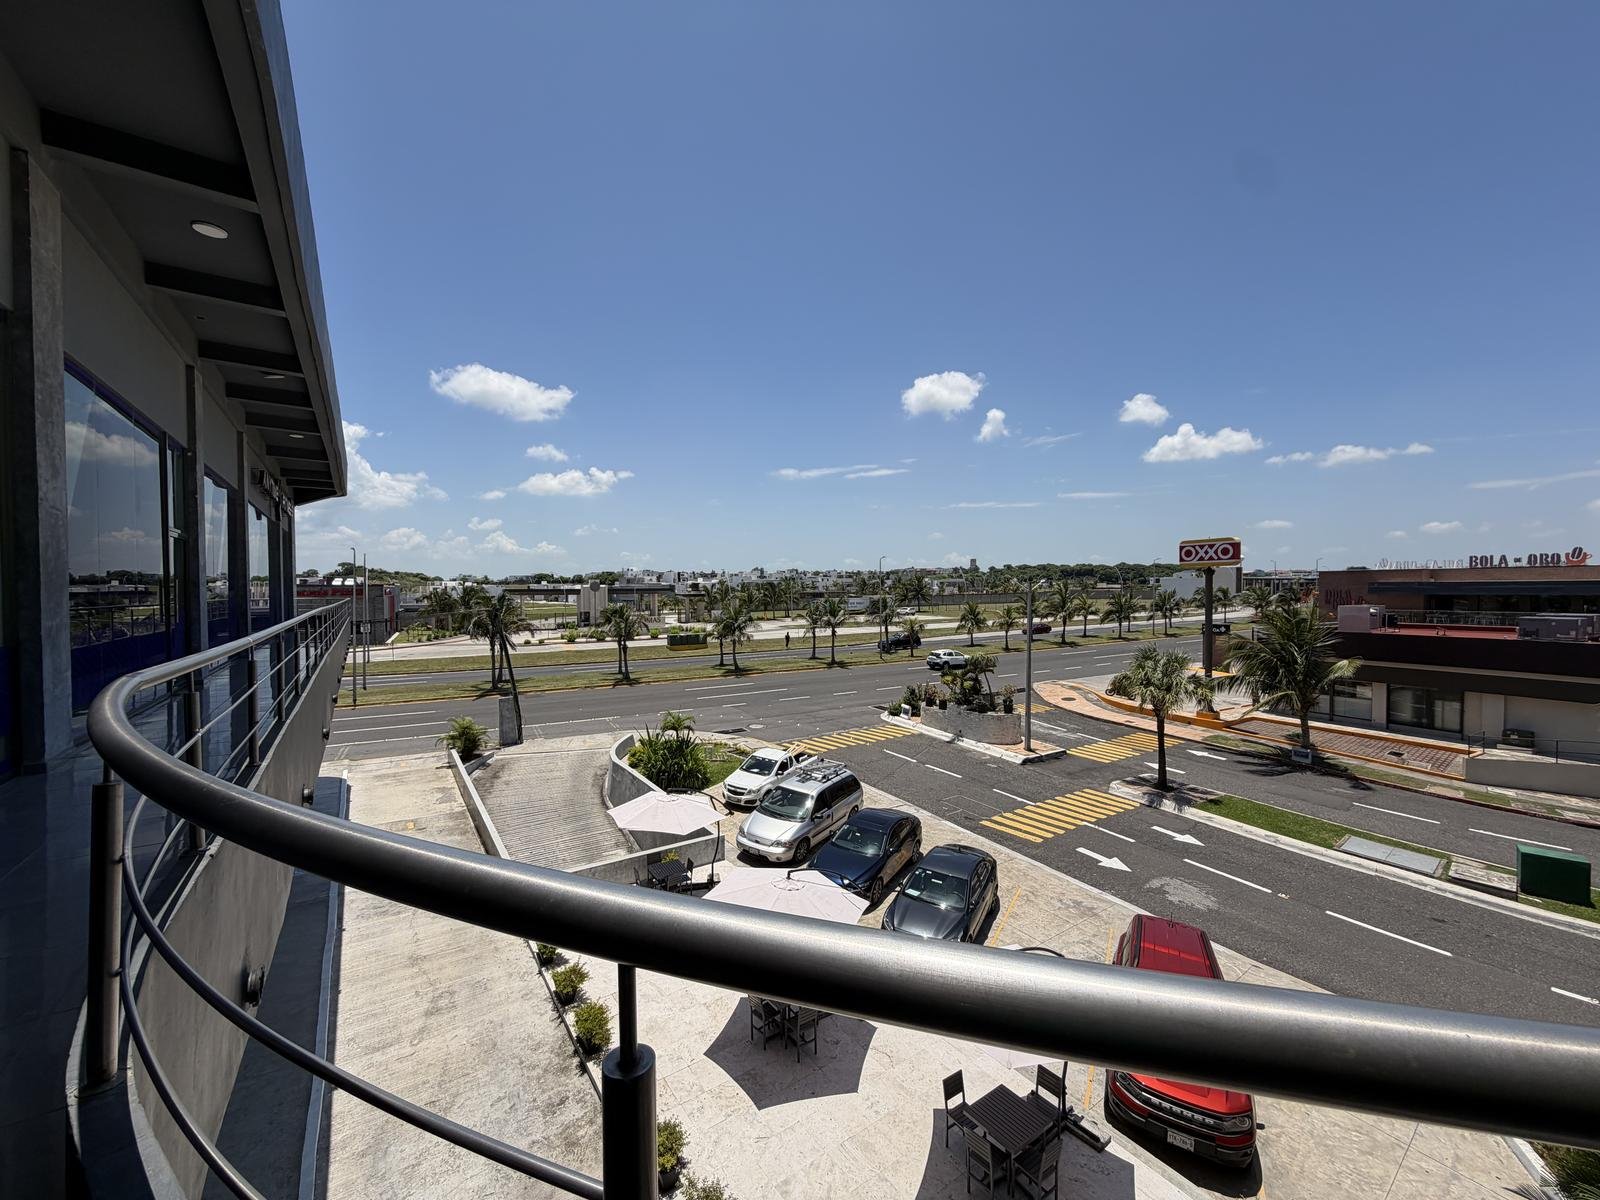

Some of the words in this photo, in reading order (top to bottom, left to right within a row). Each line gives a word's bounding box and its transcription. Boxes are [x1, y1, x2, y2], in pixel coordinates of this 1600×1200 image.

[1181, 543, 1233, 561] OXXO
[1469, 554, 1508, 567] BOLA
[1527, 553, 1561, 566] ORO
